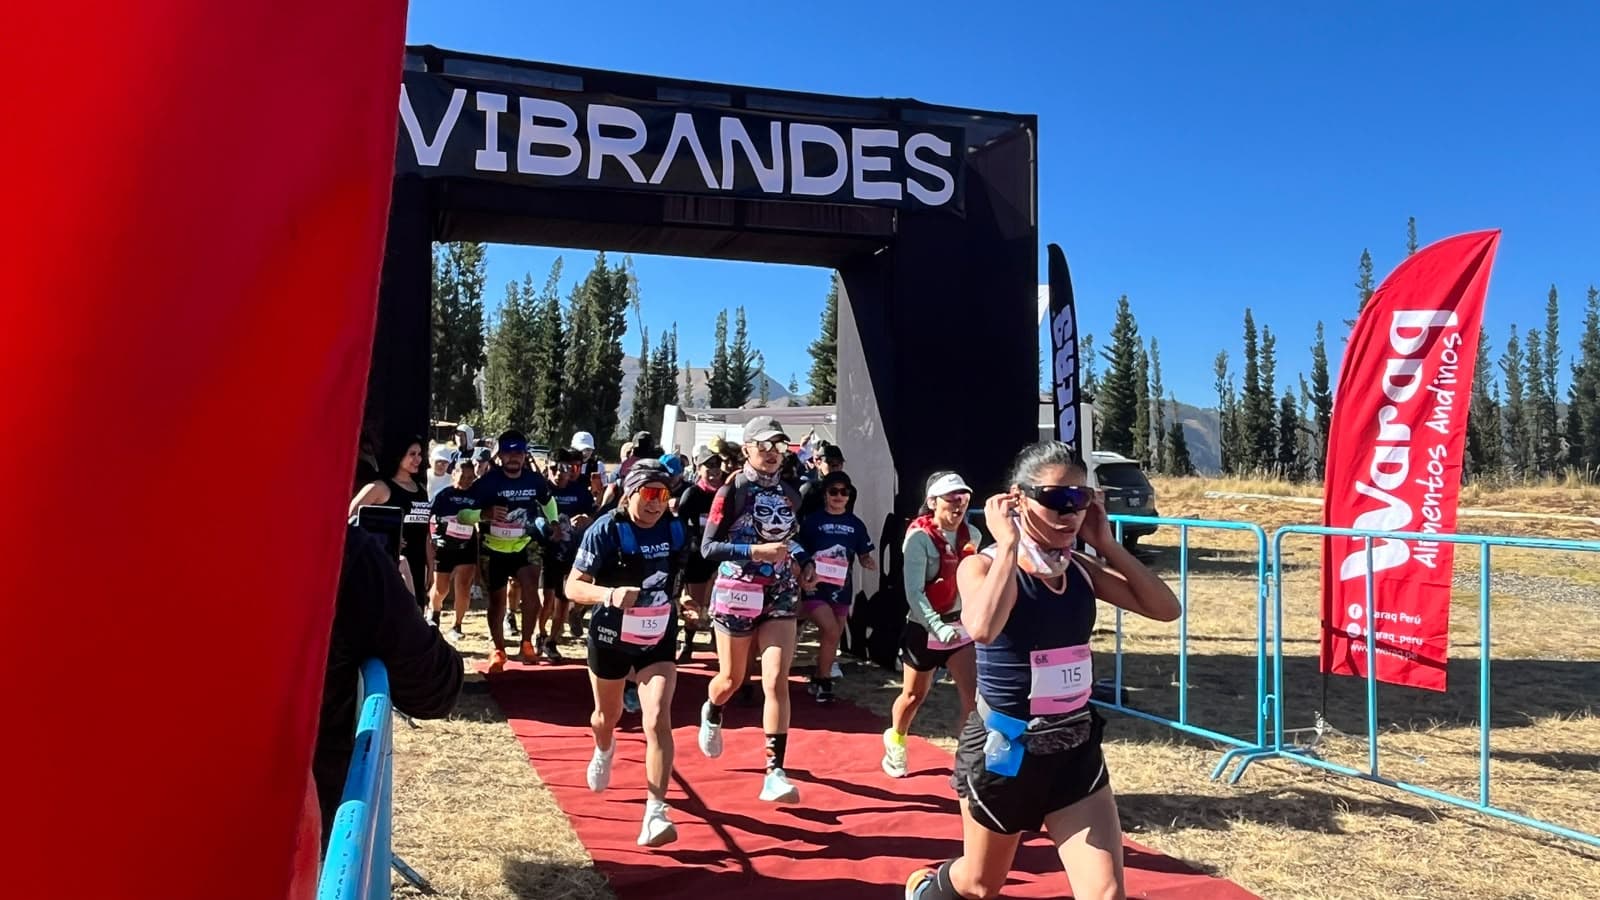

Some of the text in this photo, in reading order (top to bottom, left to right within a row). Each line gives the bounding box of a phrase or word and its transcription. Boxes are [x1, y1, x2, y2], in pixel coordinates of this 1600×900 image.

[398, 83, 955, 206] VIBRANDES
[1429, 332, 1462, 434] Andinos
[1340, 310, 1458, 581] Waraq
[731, 592, 748, 602] 140
[642, 620, 658, 629] 135
[1365, 606, 1421, 625] araq Perú
[1061, 666, 1082, 684] 115
